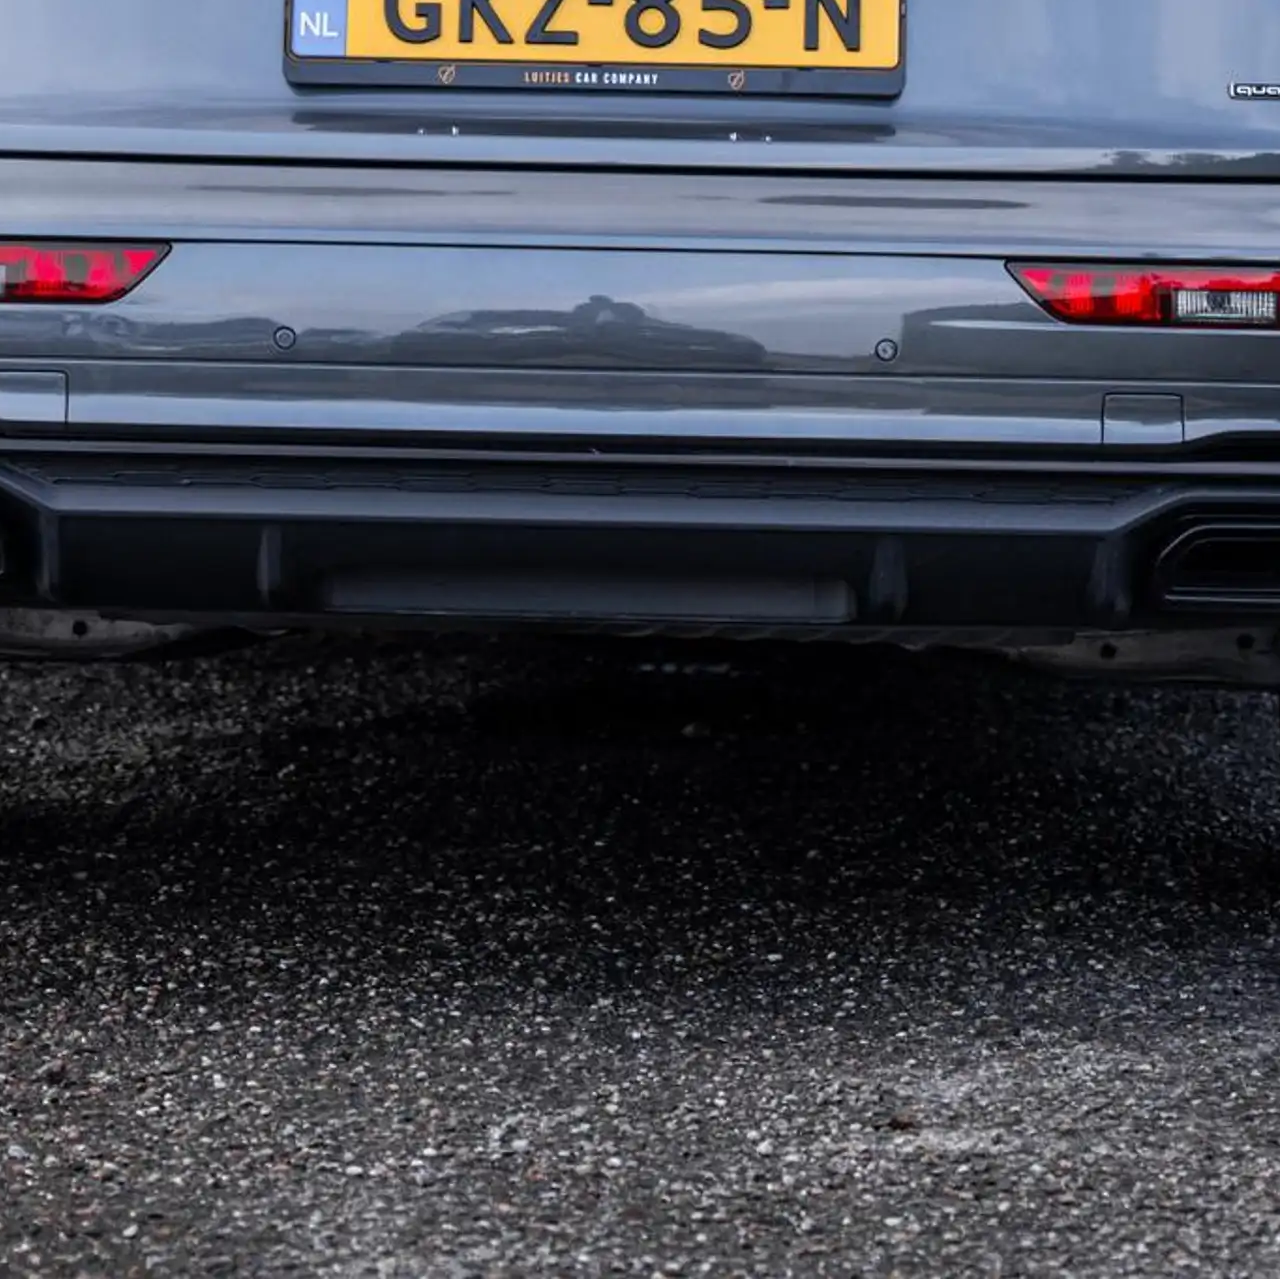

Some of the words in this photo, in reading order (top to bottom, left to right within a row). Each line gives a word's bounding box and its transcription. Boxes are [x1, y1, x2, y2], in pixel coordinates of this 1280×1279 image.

[300, 12, 338, 38] NL
[575, 72, 598, 84] CAR
[604, 73, 658, 85] COMPANY
